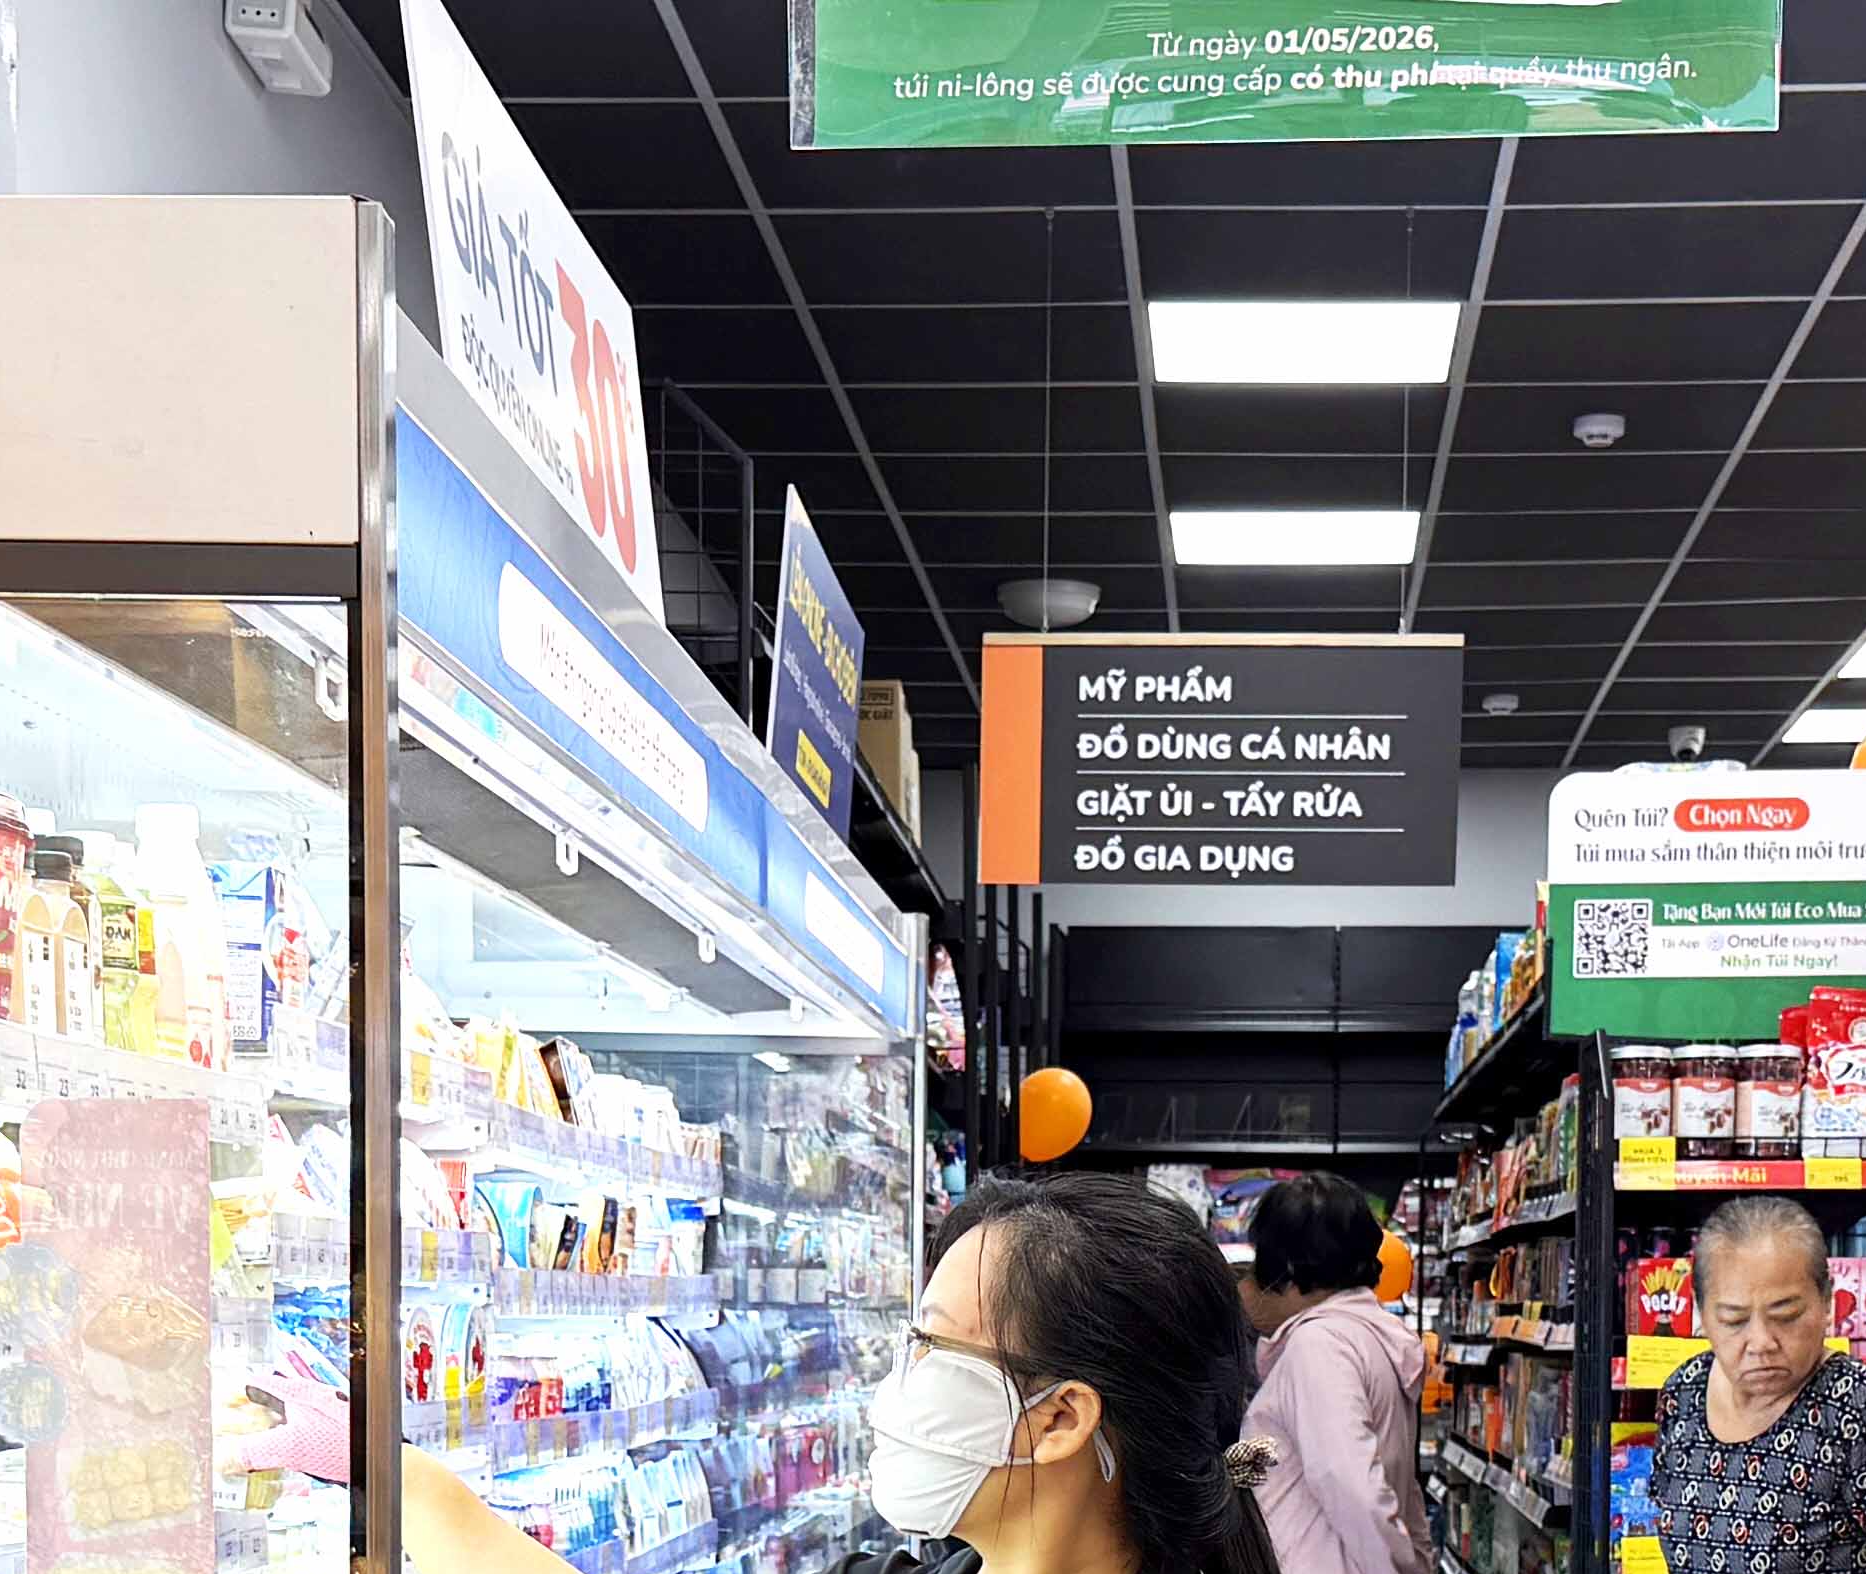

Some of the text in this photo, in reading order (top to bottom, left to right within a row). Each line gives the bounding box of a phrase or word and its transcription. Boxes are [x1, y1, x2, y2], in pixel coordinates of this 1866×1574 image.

[1147, 25, 1439, 62] Từ ngày 01/05/2026,
[894, 71, 928, 98] túi
[937, 71, 1034, 99] ni-lông
[1043, 67, 1074, 96] sẽ
[1081, 73, 1149, 97] được
[1157, 74, 1224, 99] cung
[1233, 64, 1282, 96] cấp
[1290, 62, 1324, 90] có
[1332, 65, 1383, 89] thu
[1618, 56, 1698, 86] ngân.
[441, 132, 558, 398] GIÁ TỐT
[1078, 665, 1232, 702] MỸ PHẨM
[1076, 723, 1390, 760] ĐỒ DÙNG CÁ NHÂN
[1076, 783, 1151, 823] GIẶT
[1160, 783, 1192, 817] ỦI
[1224, 780, 1284, 817] TẨY
[1294, 780, 1363, 817] RỬA
[1574, 808, 1626, 832] Quên
[1688, 803, 1798, 829] Chọn Ngay
[1075, 834, 1294, 879] ĐỒ GIA DỤNG
[1605, 848, 1646, 863] mua
[1651, 839, 1691, 863] sắm
[1697, 842, 1737, 862] thân
[1743, 841, 1791, 865] thiện
[1796, 841, 1833, 861] môi
[1794, 902, 1824, 919] Eco
[1727, 934, 1790, 949] OneLife
